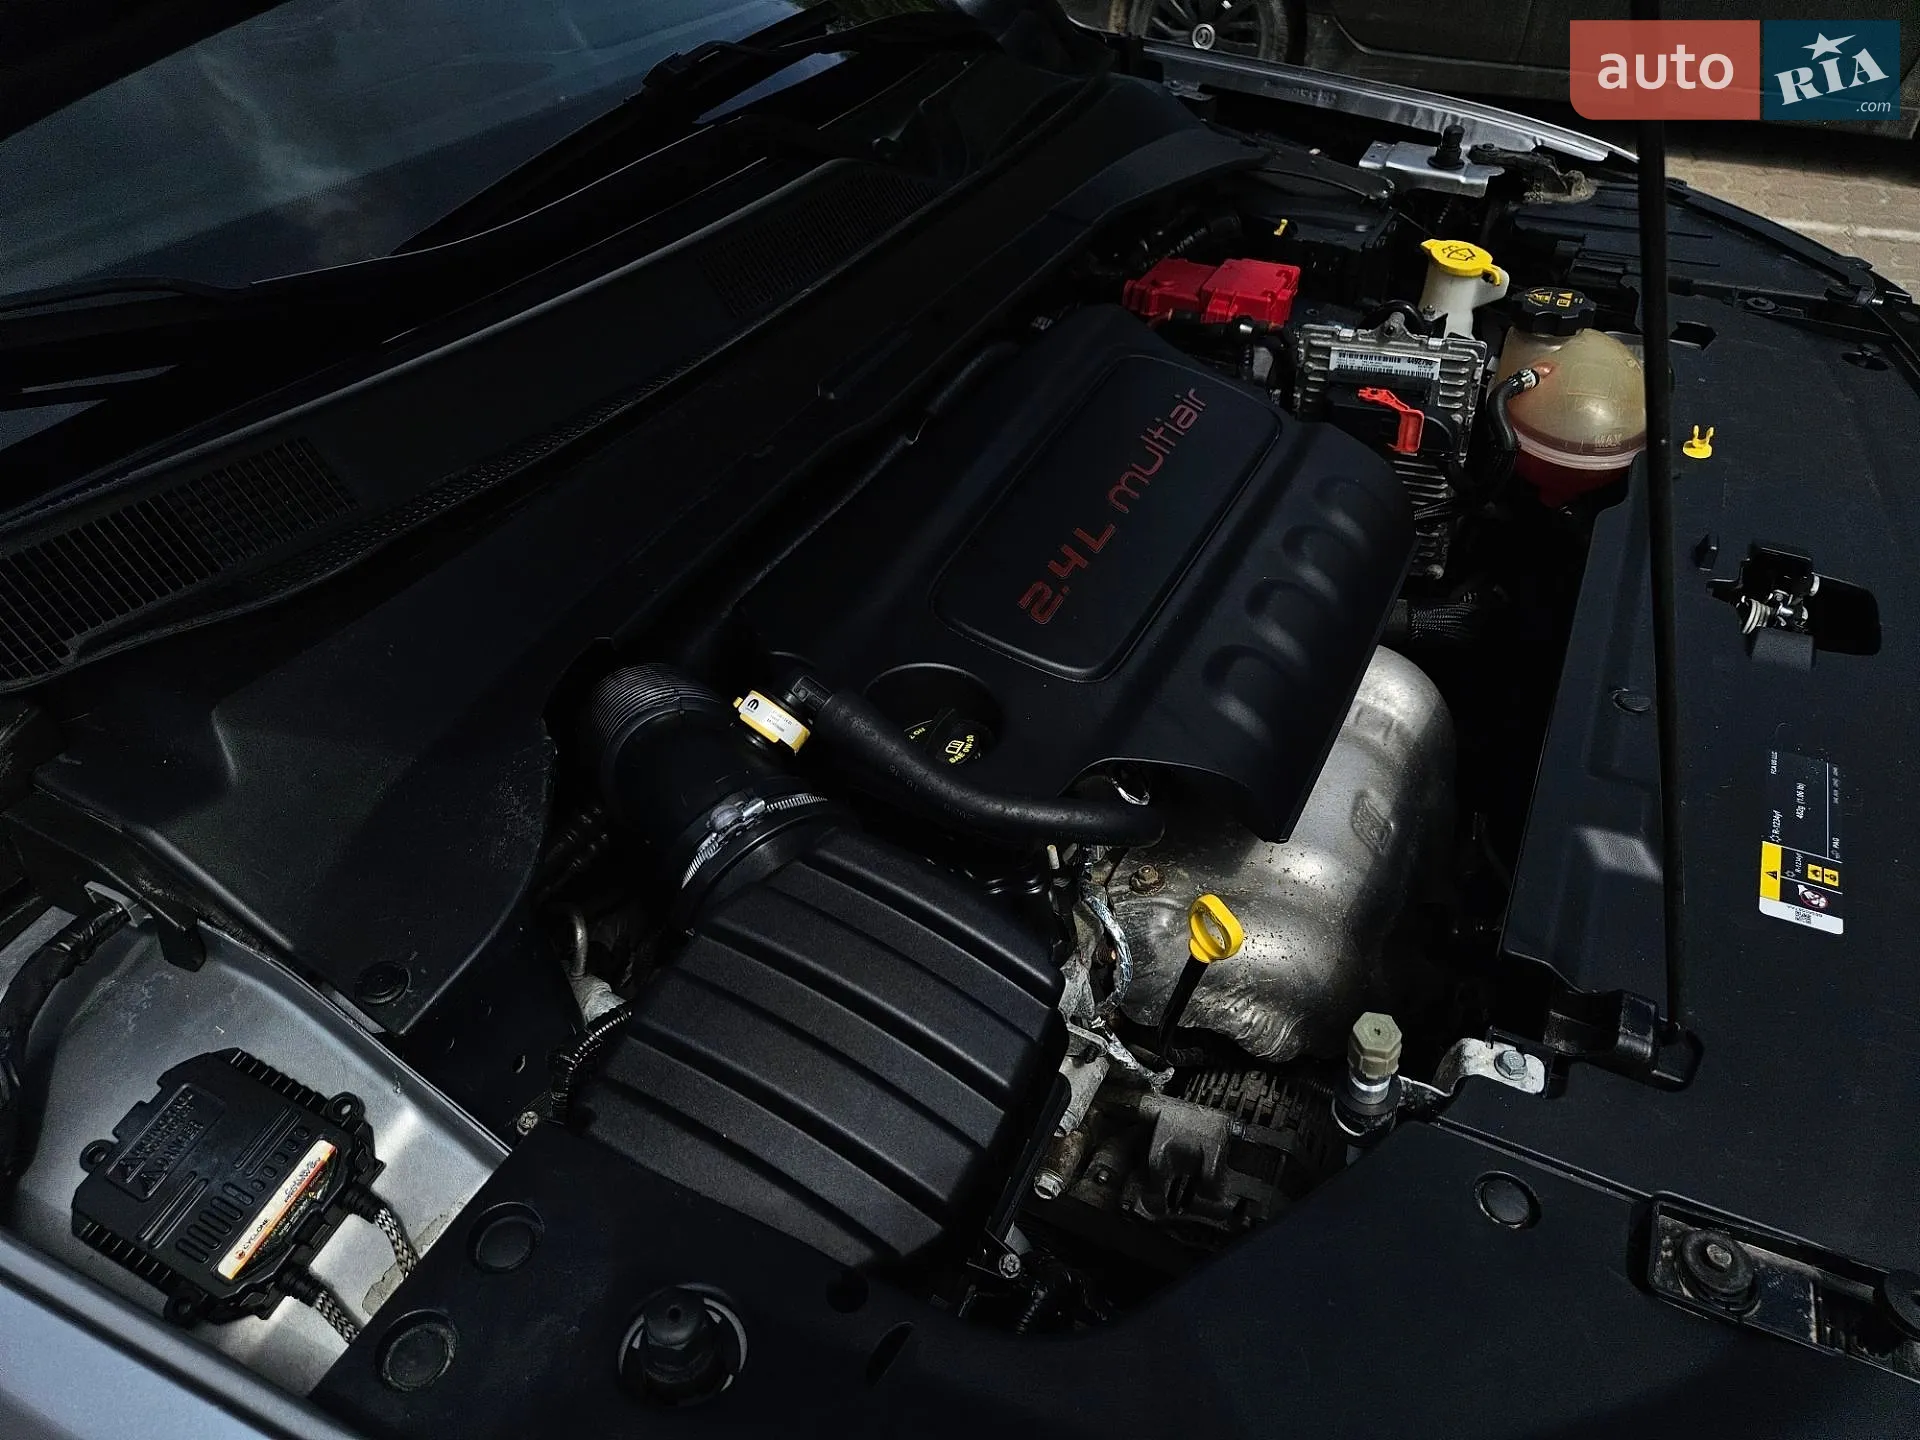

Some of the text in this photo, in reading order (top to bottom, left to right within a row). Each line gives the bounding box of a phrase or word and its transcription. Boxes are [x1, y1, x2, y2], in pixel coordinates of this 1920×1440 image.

[1016, 387, 1207, 625] 2.4L multiair
[1772, 809, 1783, 835] R-1234yf
[243, 1218, 269, 1251] CYCLONE
